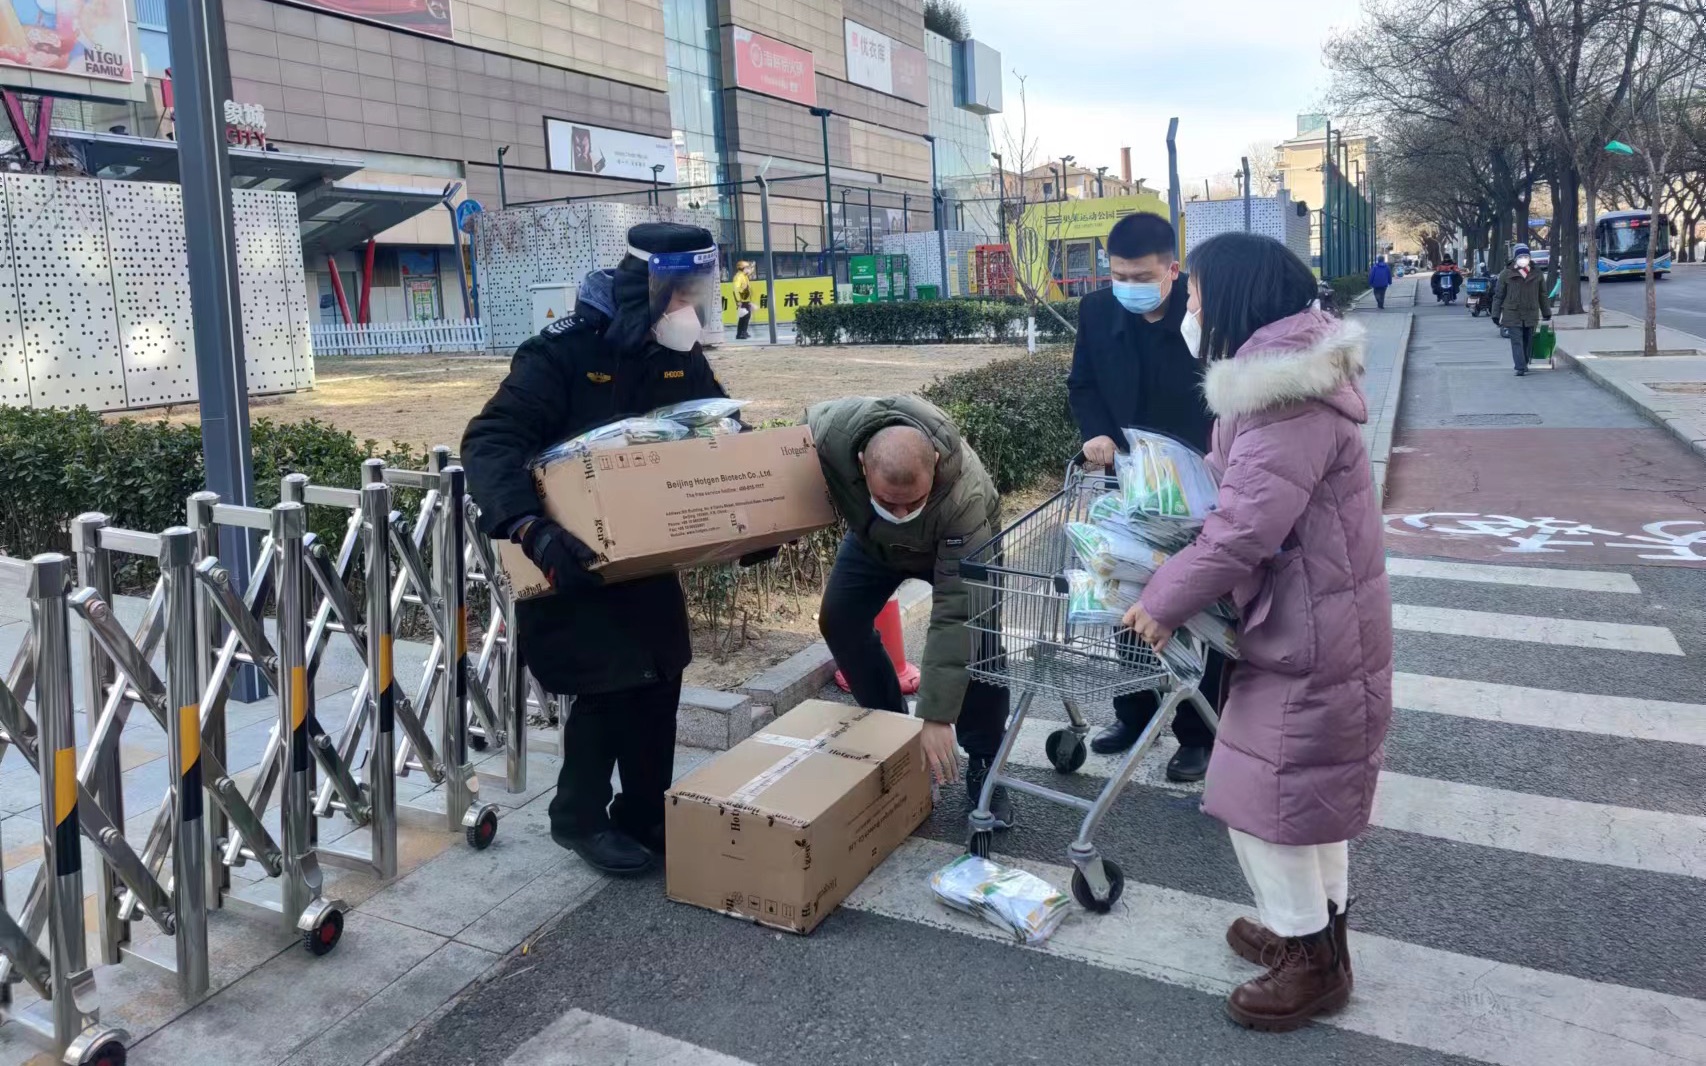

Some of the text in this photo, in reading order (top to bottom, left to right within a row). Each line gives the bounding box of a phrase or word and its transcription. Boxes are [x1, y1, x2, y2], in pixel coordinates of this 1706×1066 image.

[83, 47, 123, 66] NIGU
[85, 62, 124, 77] FAMILY
[781, 445, 808, 457] Hotgen
[666, 479, 694, 490] Beijing
[694, 475, 720, 487] Hotgen
[720, 472, 747, 483] Biotech
[828, 748, 862, 761] Hotgen
[678, 790, 712, 805] Hotgen
